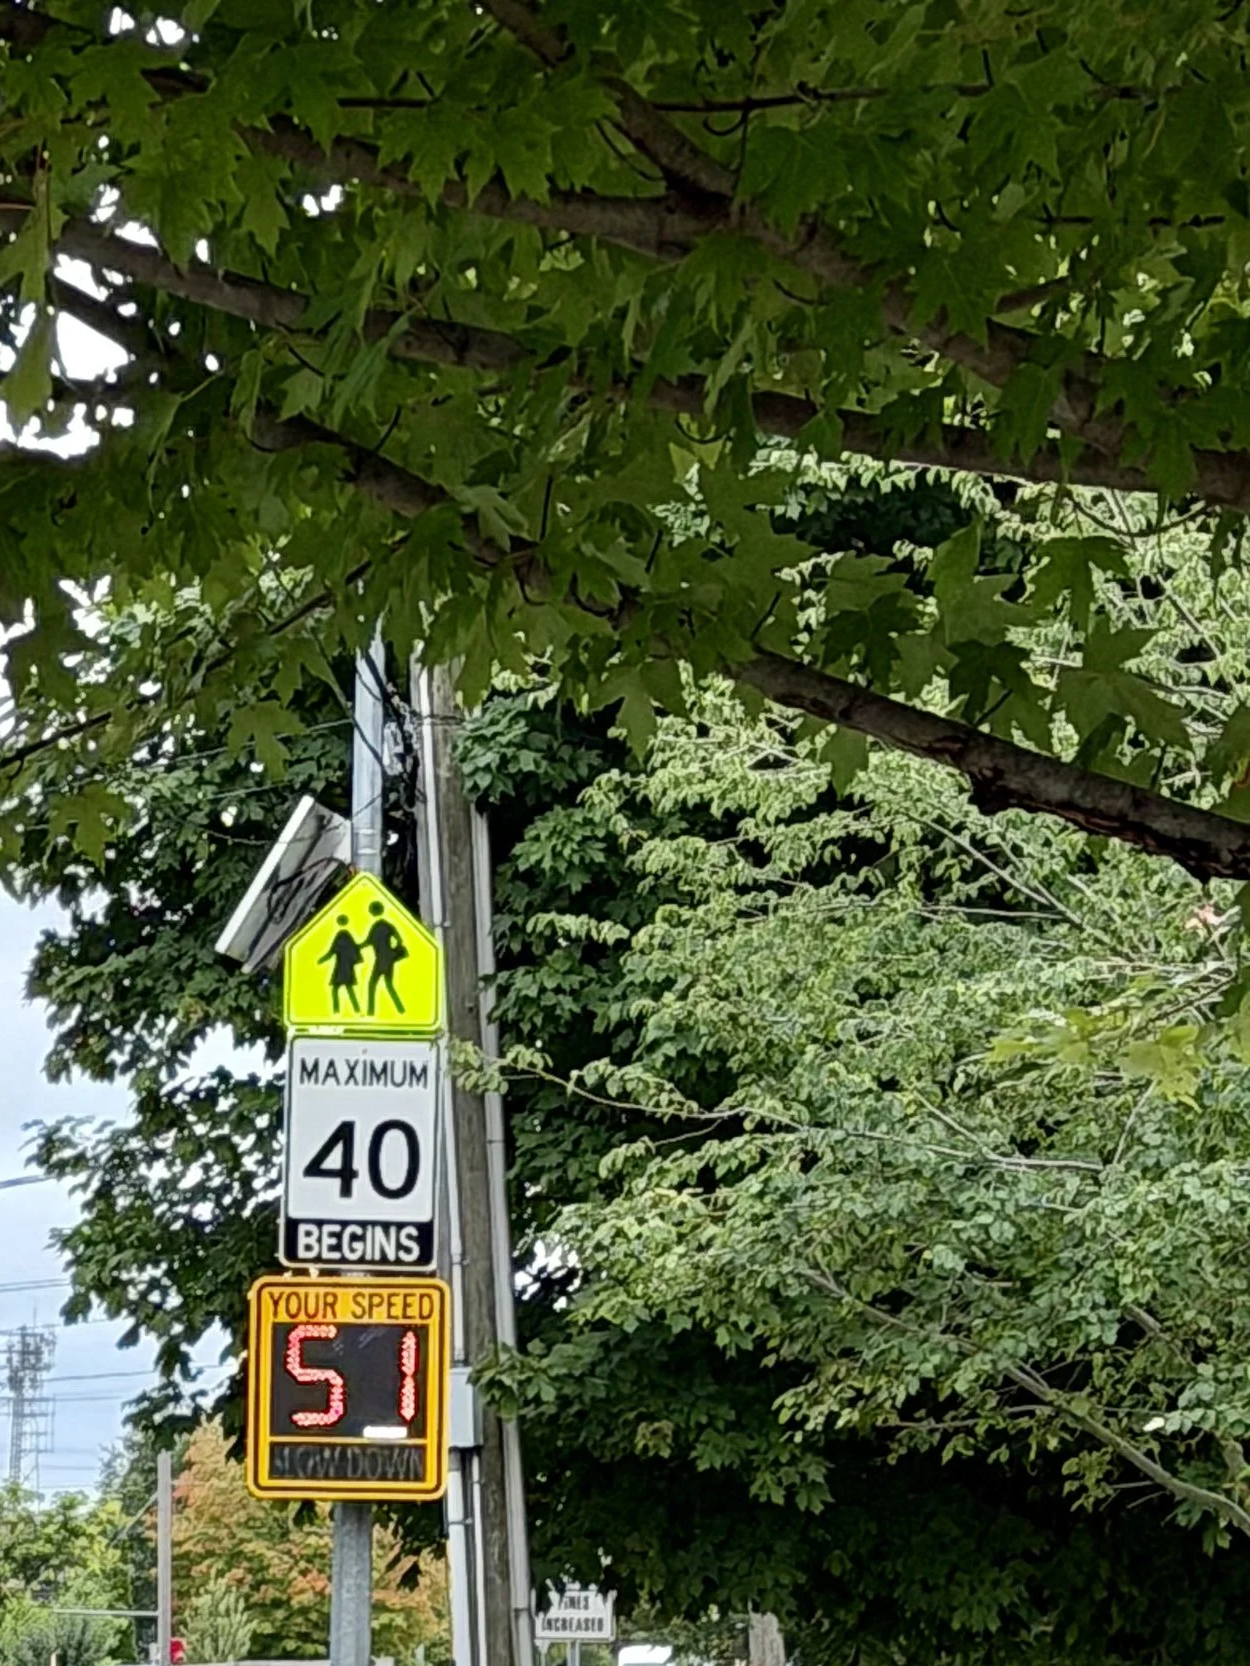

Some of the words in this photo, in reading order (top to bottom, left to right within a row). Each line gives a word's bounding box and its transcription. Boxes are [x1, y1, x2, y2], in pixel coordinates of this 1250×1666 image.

[299, 1057, 429, 1089] MAXIMUM
[303, 1118, 421, 1200] 40
[296, 1222, 421, 1263] BEGINS
[269, 1291, 339, 1319] YOUR
[350, 1292, 434, 1320] SPEED
[286, 1323, 418, 1427] 51
[347, 1446, 425, 1480] DOWN
[542, 1617, 604, 1632] INCREASED
